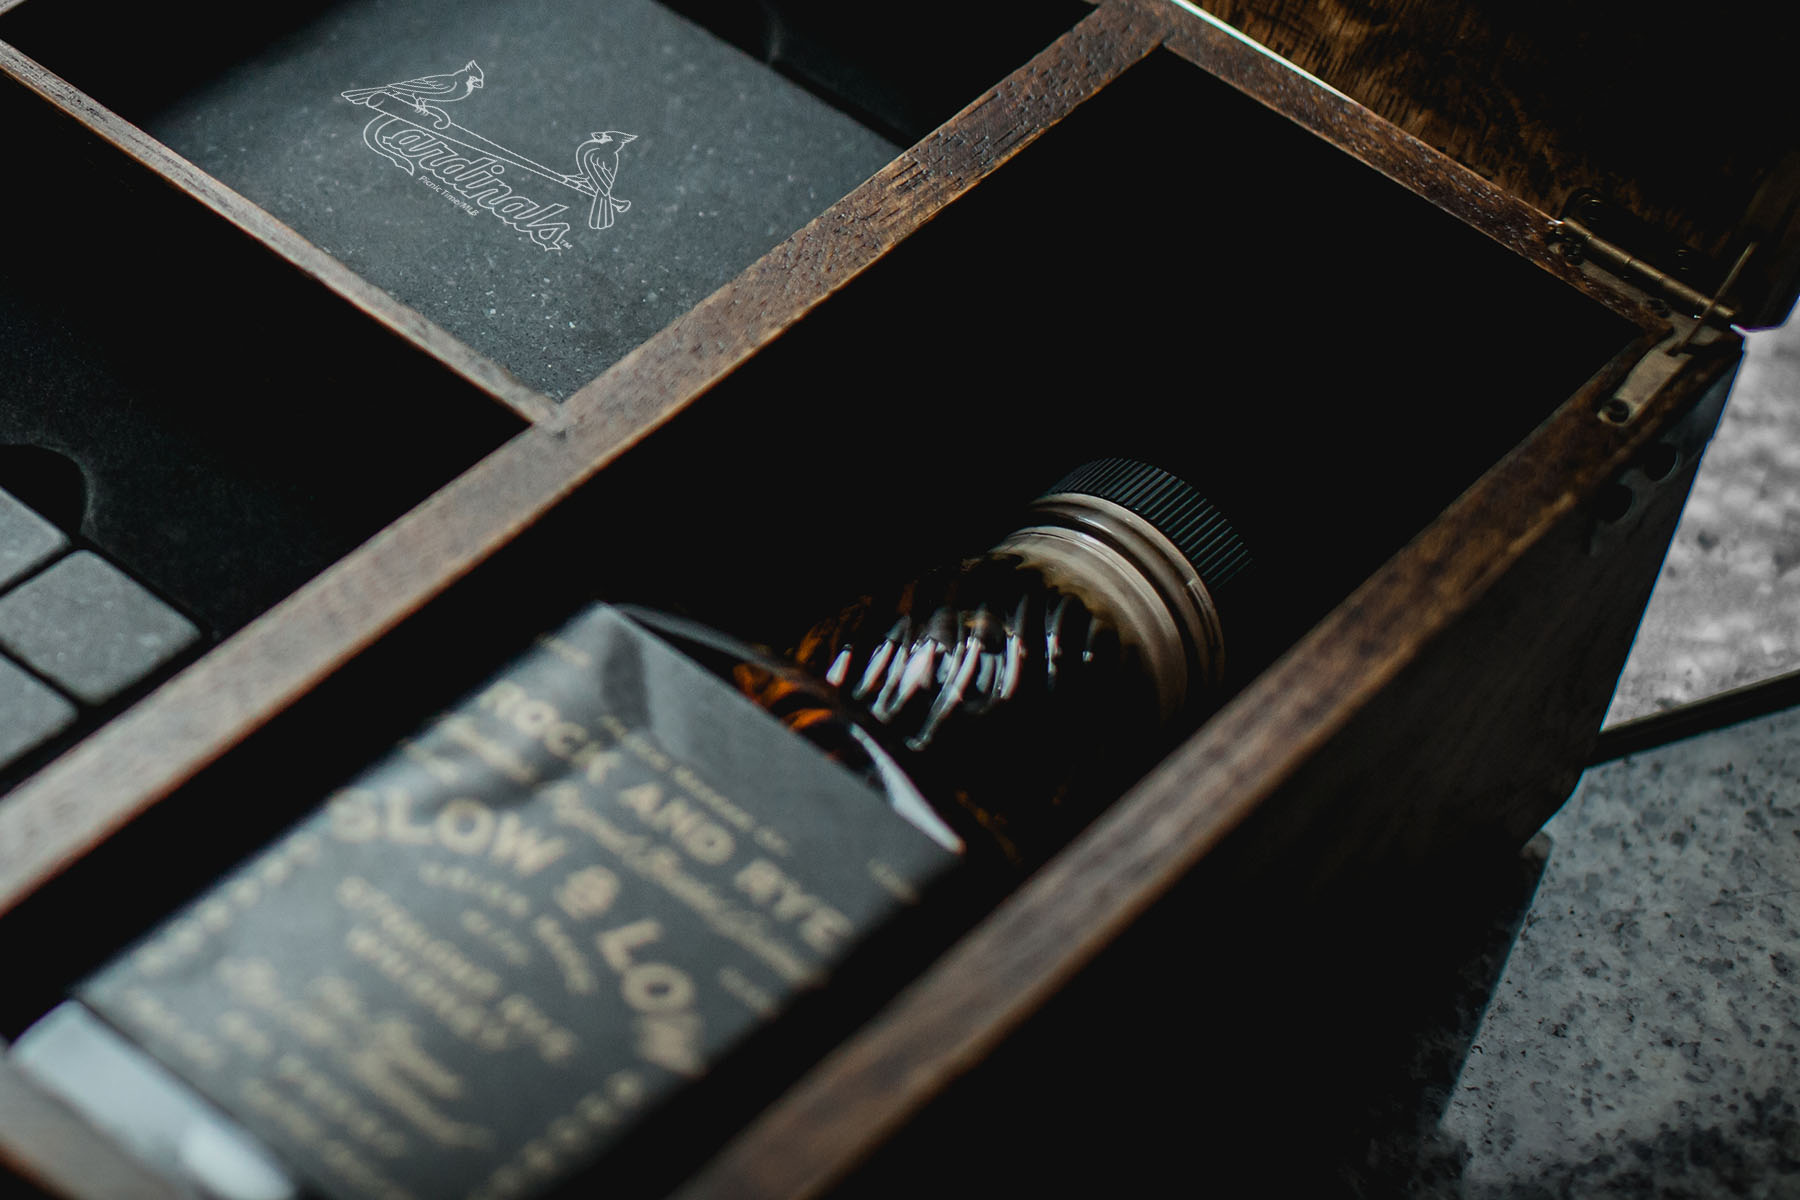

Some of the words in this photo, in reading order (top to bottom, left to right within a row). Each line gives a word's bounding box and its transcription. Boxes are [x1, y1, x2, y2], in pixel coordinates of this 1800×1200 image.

[363, 113, 570, 251] Cardinals
[418, 175, 443, 194] Picnic
[327, 786, 570, 878] SLOW
[619, 781, 736, 866] AND
[735, 858, 855, 956] RYE
